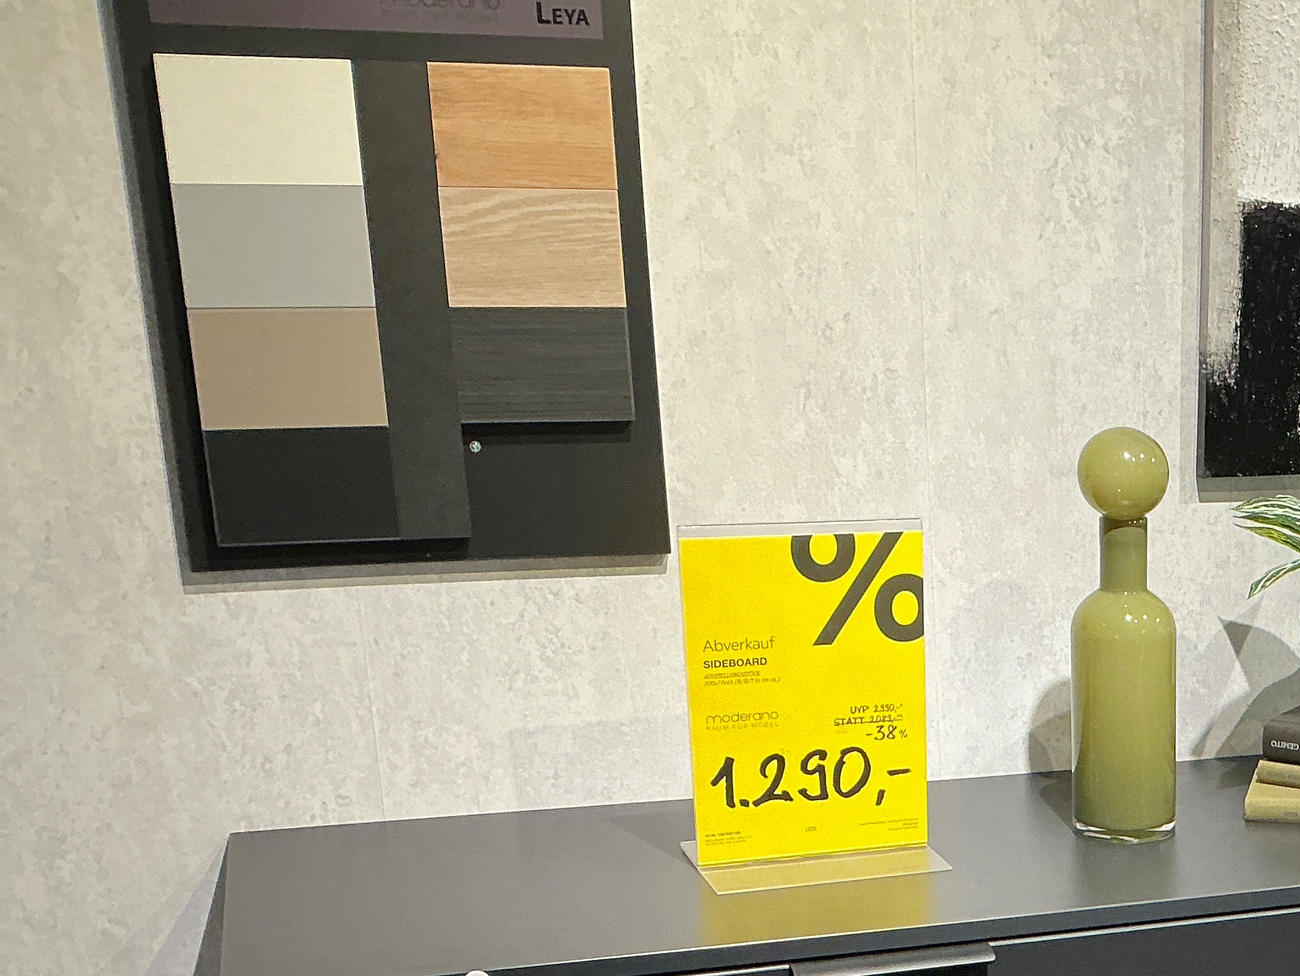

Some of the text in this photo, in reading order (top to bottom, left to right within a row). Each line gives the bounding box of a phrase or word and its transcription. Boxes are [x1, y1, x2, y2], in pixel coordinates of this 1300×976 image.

[703, 636, 775, 653] Abverkauf
[703, 656, 768, 669] SIDEBOARD
[705, 711, 779, 724] moderano
[834, 716, 866, 727] STATT
[1270, 740, 1300, 752] GEMITO
